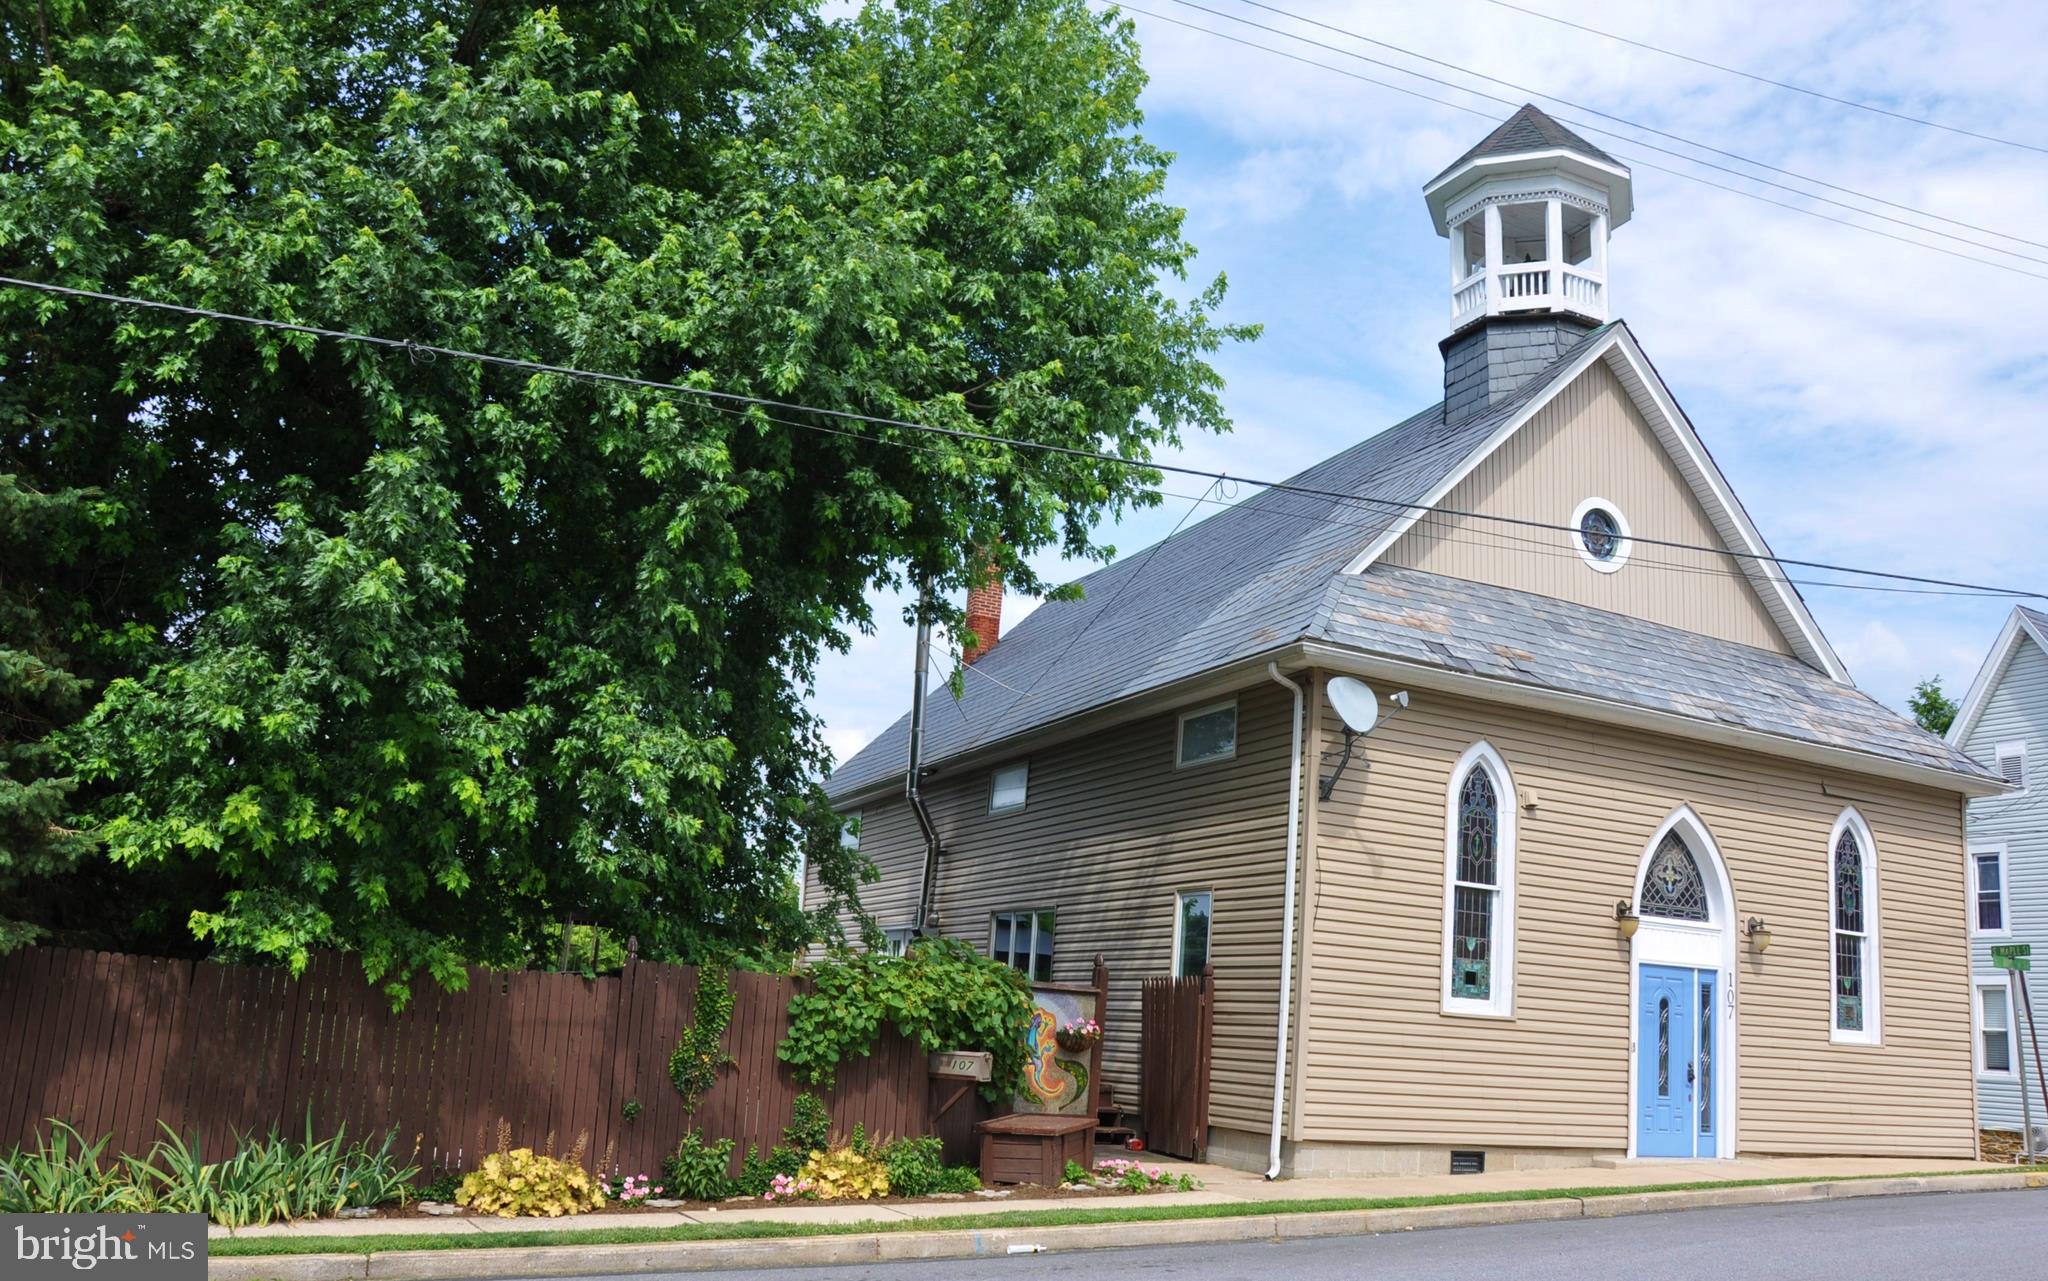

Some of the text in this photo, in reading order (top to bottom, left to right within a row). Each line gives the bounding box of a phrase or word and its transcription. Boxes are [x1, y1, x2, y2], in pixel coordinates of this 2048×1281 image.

[2000, 945, 2021, 956] MAPLE
[1727, 972, 1735, 1020] 107
[951, 1060, 975, 1071] 107
